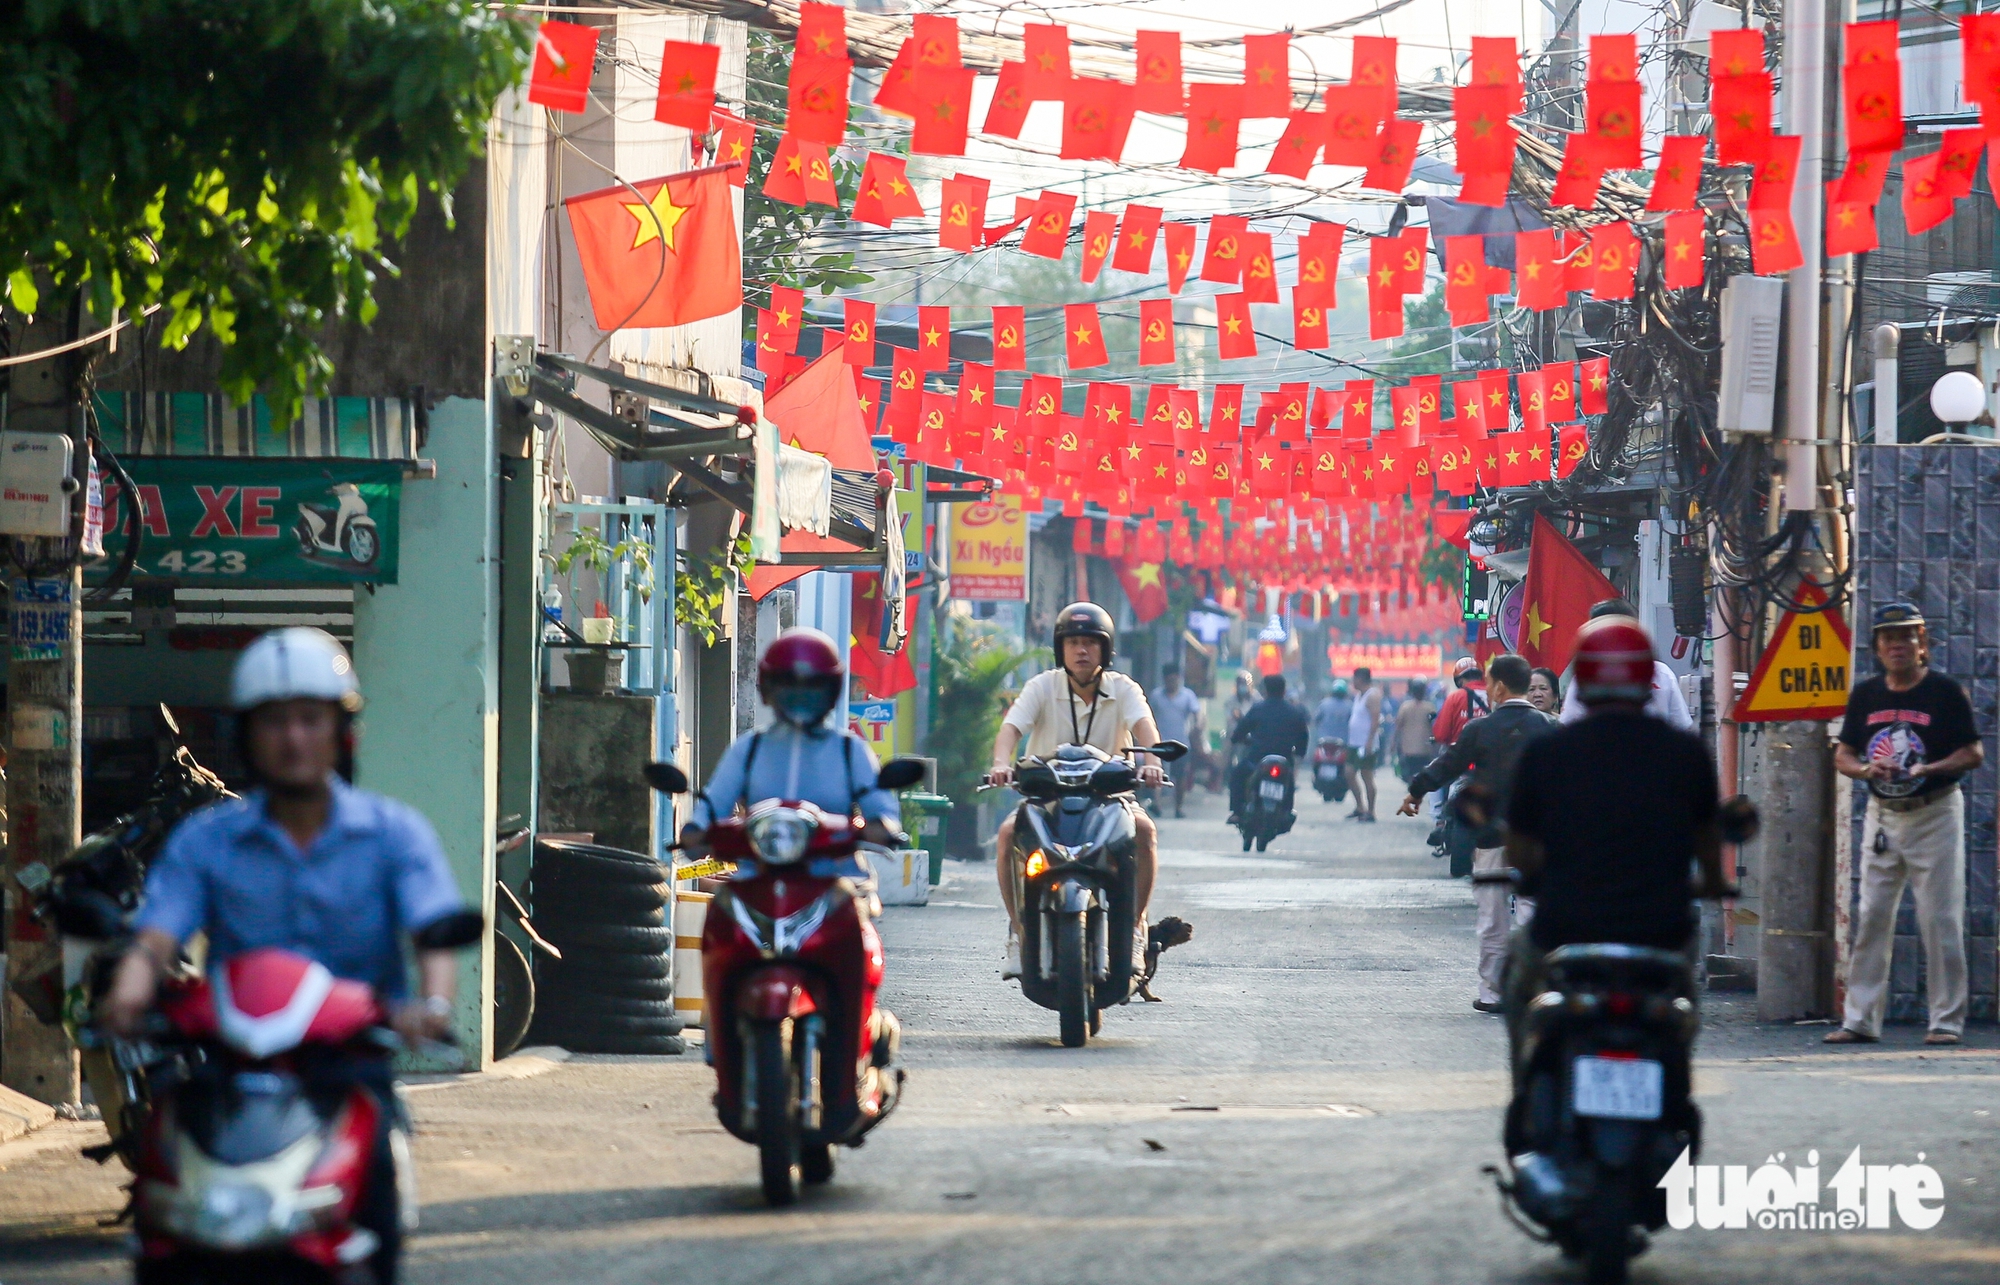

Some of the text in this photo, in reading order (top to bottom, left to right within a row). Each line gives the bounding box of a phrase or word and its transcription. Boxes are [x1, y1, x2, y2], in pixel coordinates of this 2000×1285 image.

[190, 485, 282, 538] XE
[158, 550, 246, 573] 423
[1798, 624, 1822, 650] ĐI
[1779, 662, 1846, 697] CHẬM
